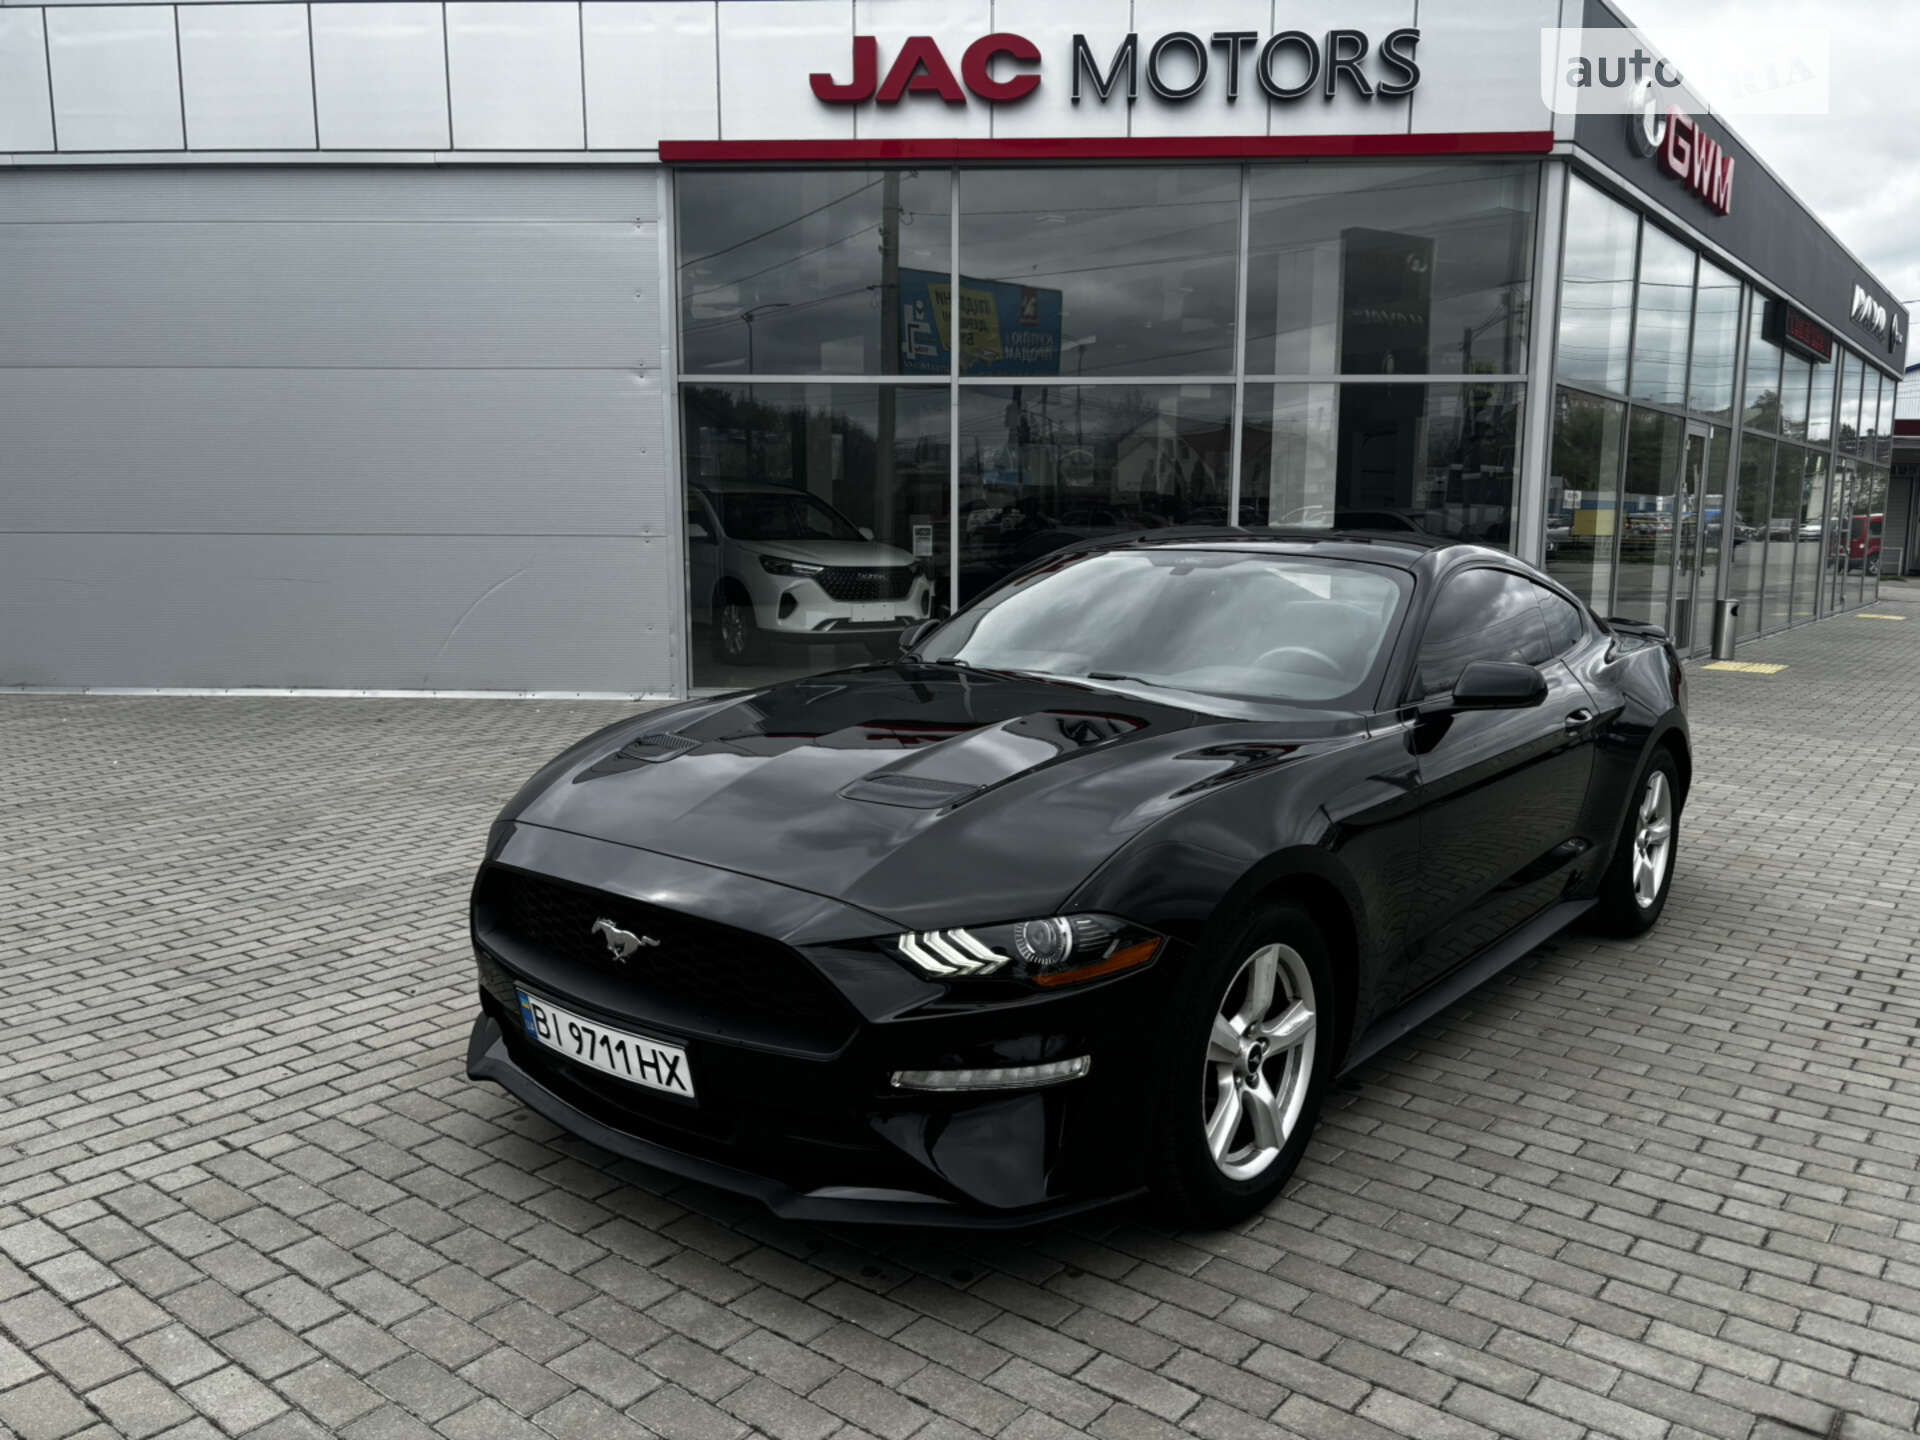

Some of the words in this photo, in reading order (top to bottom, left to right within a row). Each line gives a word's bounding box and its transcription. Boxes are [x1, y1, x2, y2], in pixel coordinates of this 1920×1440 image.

[809, 33, 1042, 104] JAC
[1070, 28, 1422, 104] MOTORS
[1660, 104, 1735, 216] GWM
[532, 1004, 563, 1046] BI
[568, 1022, 632, 1076] 9711
[635, 1044, 687, 1091] HX
